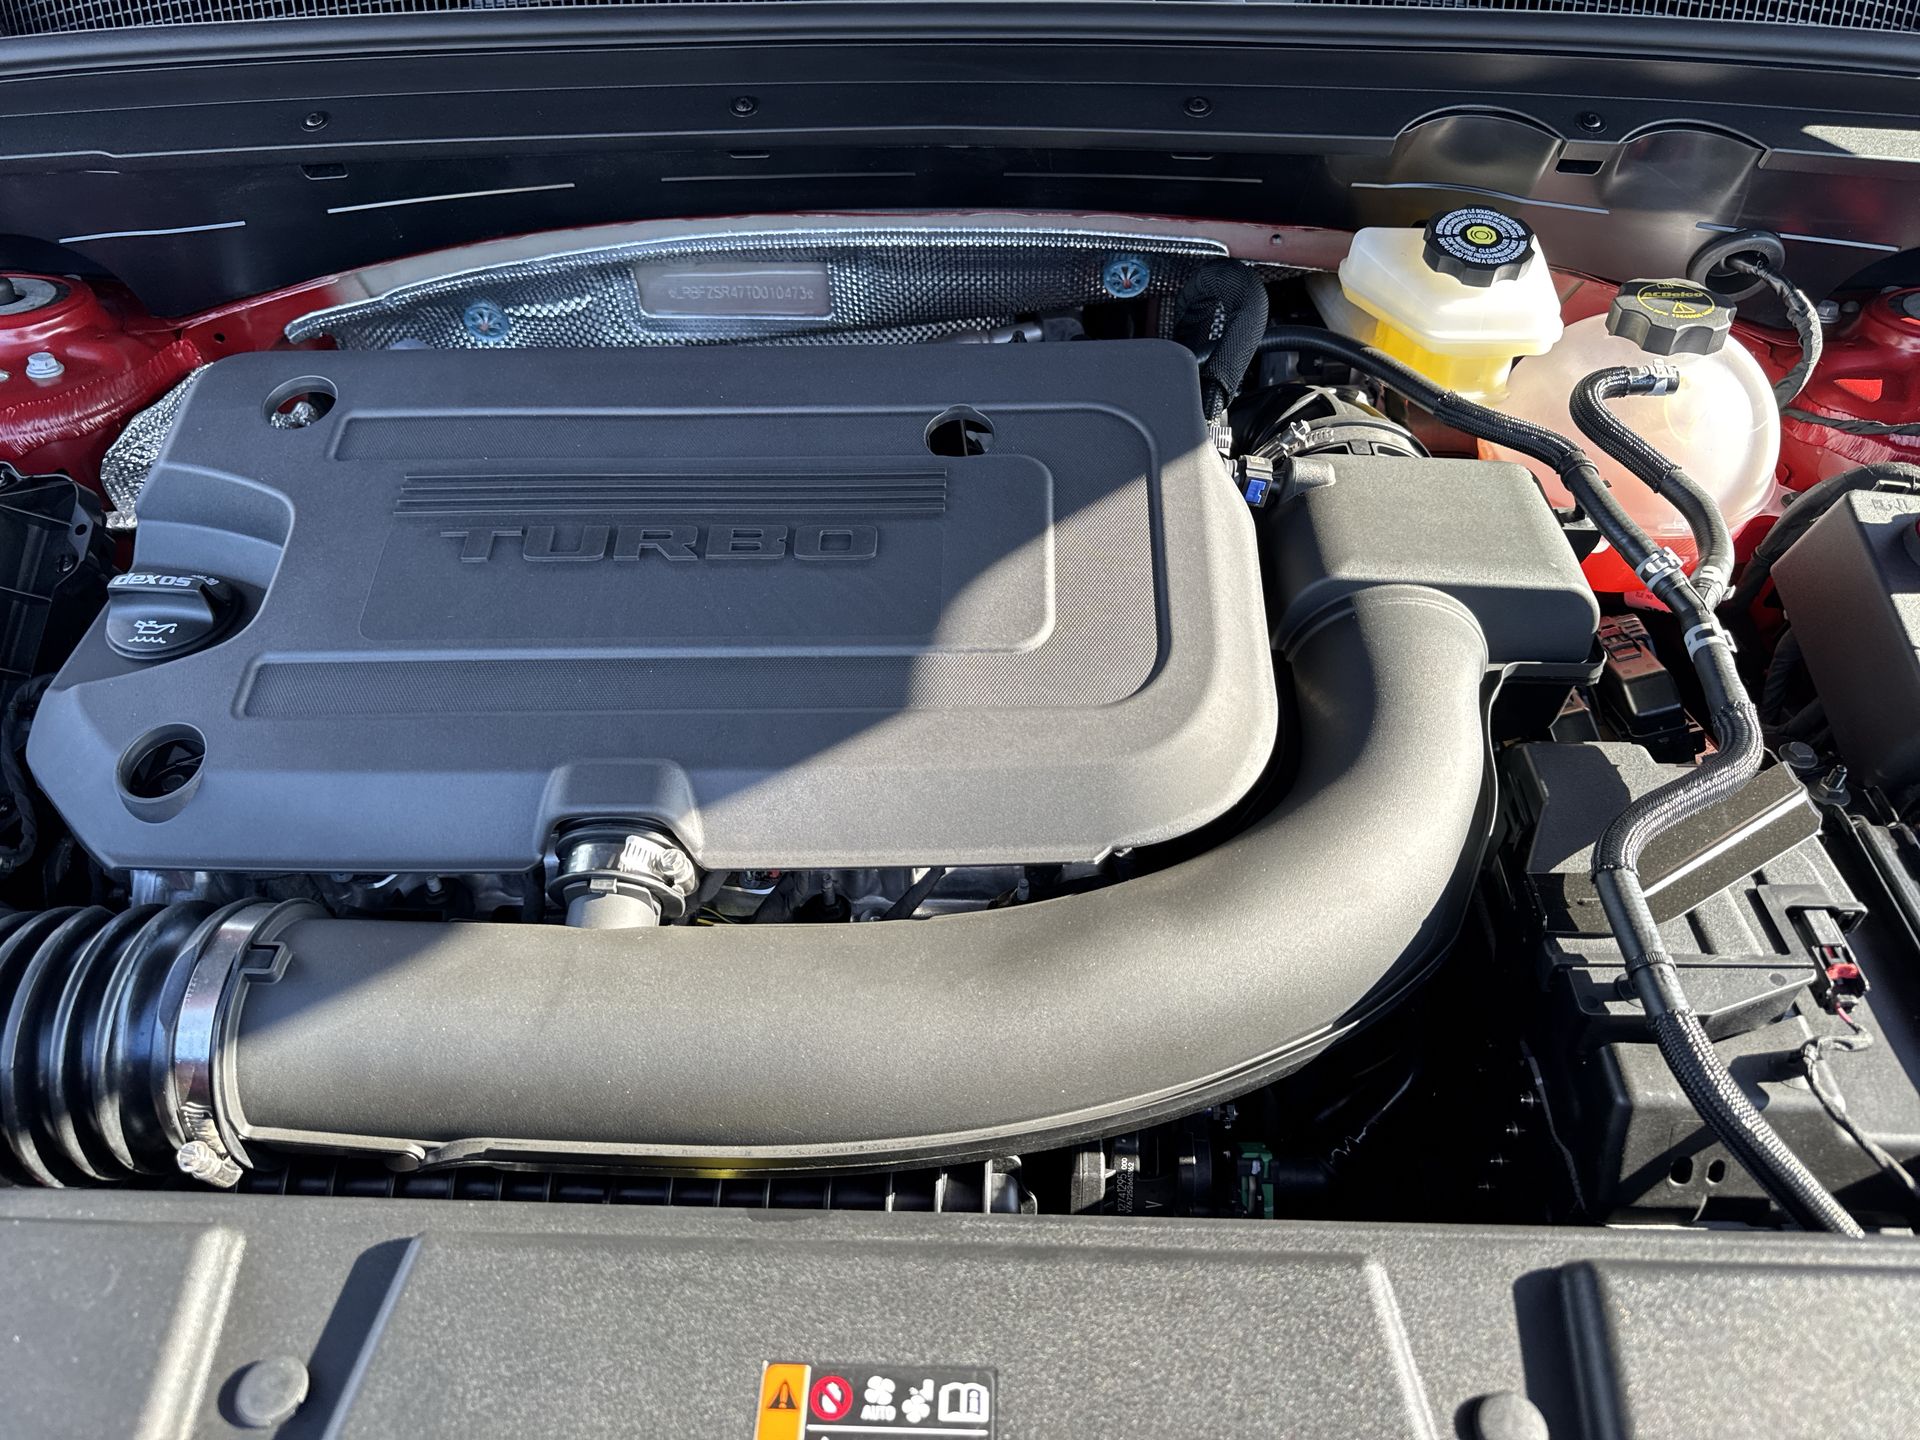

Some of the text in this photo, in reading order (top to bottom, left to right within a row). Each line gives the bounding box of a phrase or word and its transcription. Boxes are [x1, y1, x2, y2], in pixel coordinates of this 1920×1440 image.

[1463, 255, 1481, 263] FROM
[440, 524, 879, 562] TURBO
[113, 573, 193, 587] dexos
[860, 1404, 897, 1422] AUTO
